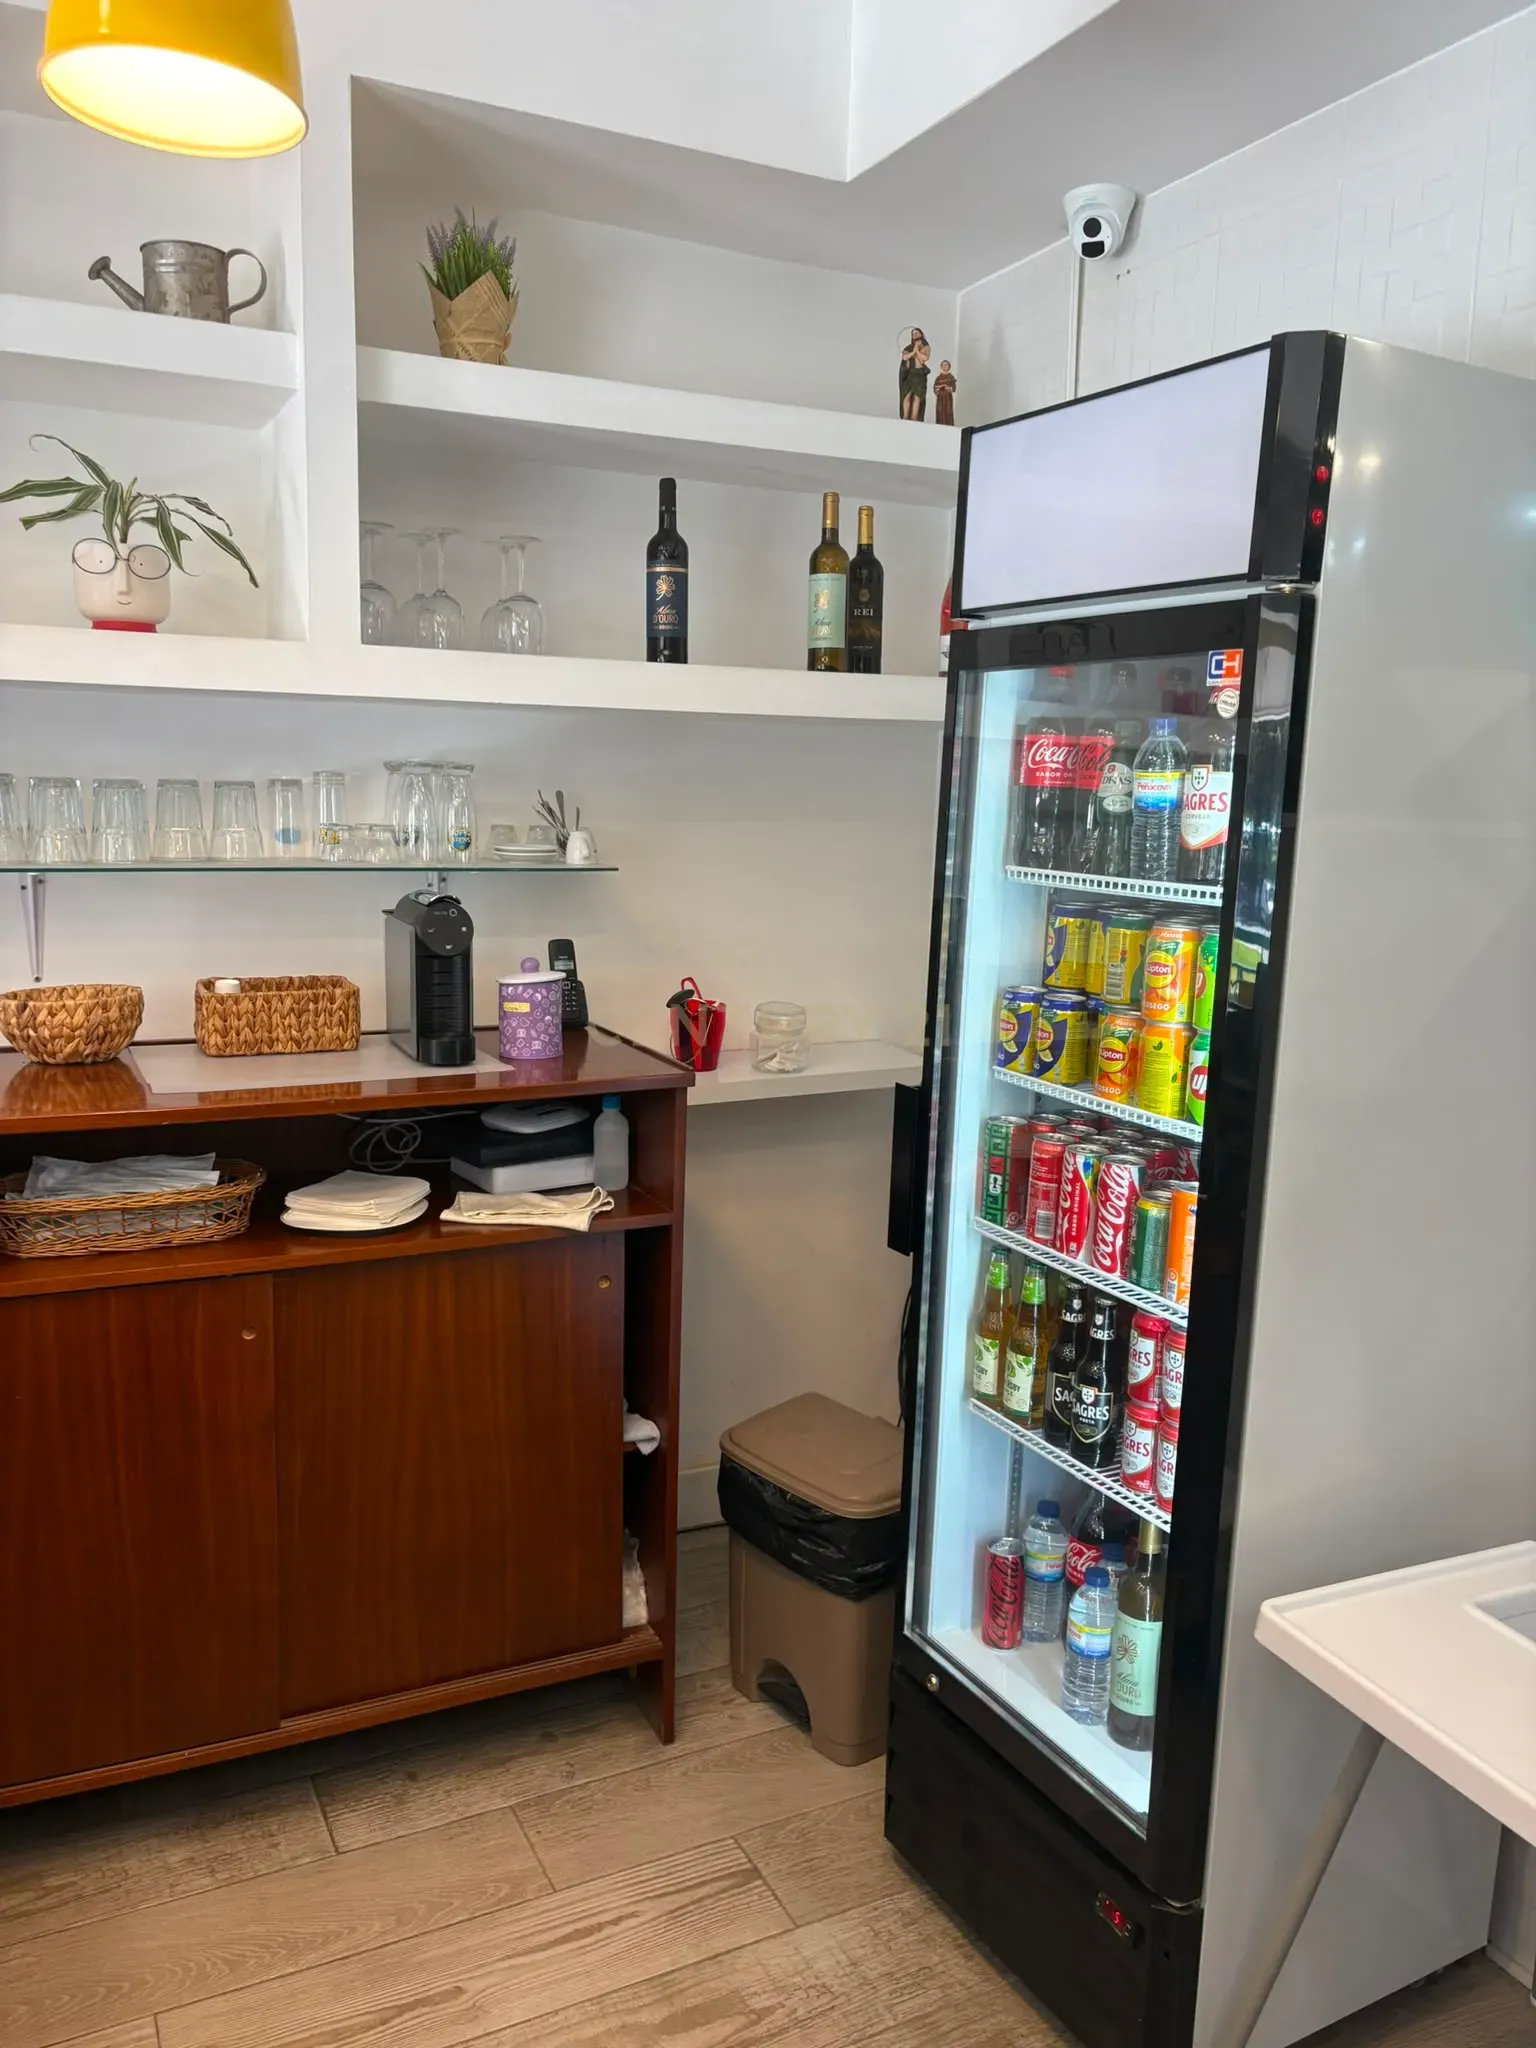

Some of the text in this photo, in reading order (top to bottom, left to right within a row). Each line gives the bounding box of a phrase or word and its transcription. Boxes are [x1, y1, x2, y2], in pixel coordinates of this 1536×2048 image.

[853, 608, 874, 616] REI
[1184, 791, 1228, 813] AGRES
[1092, 1327, 1116, 1339] GRES
